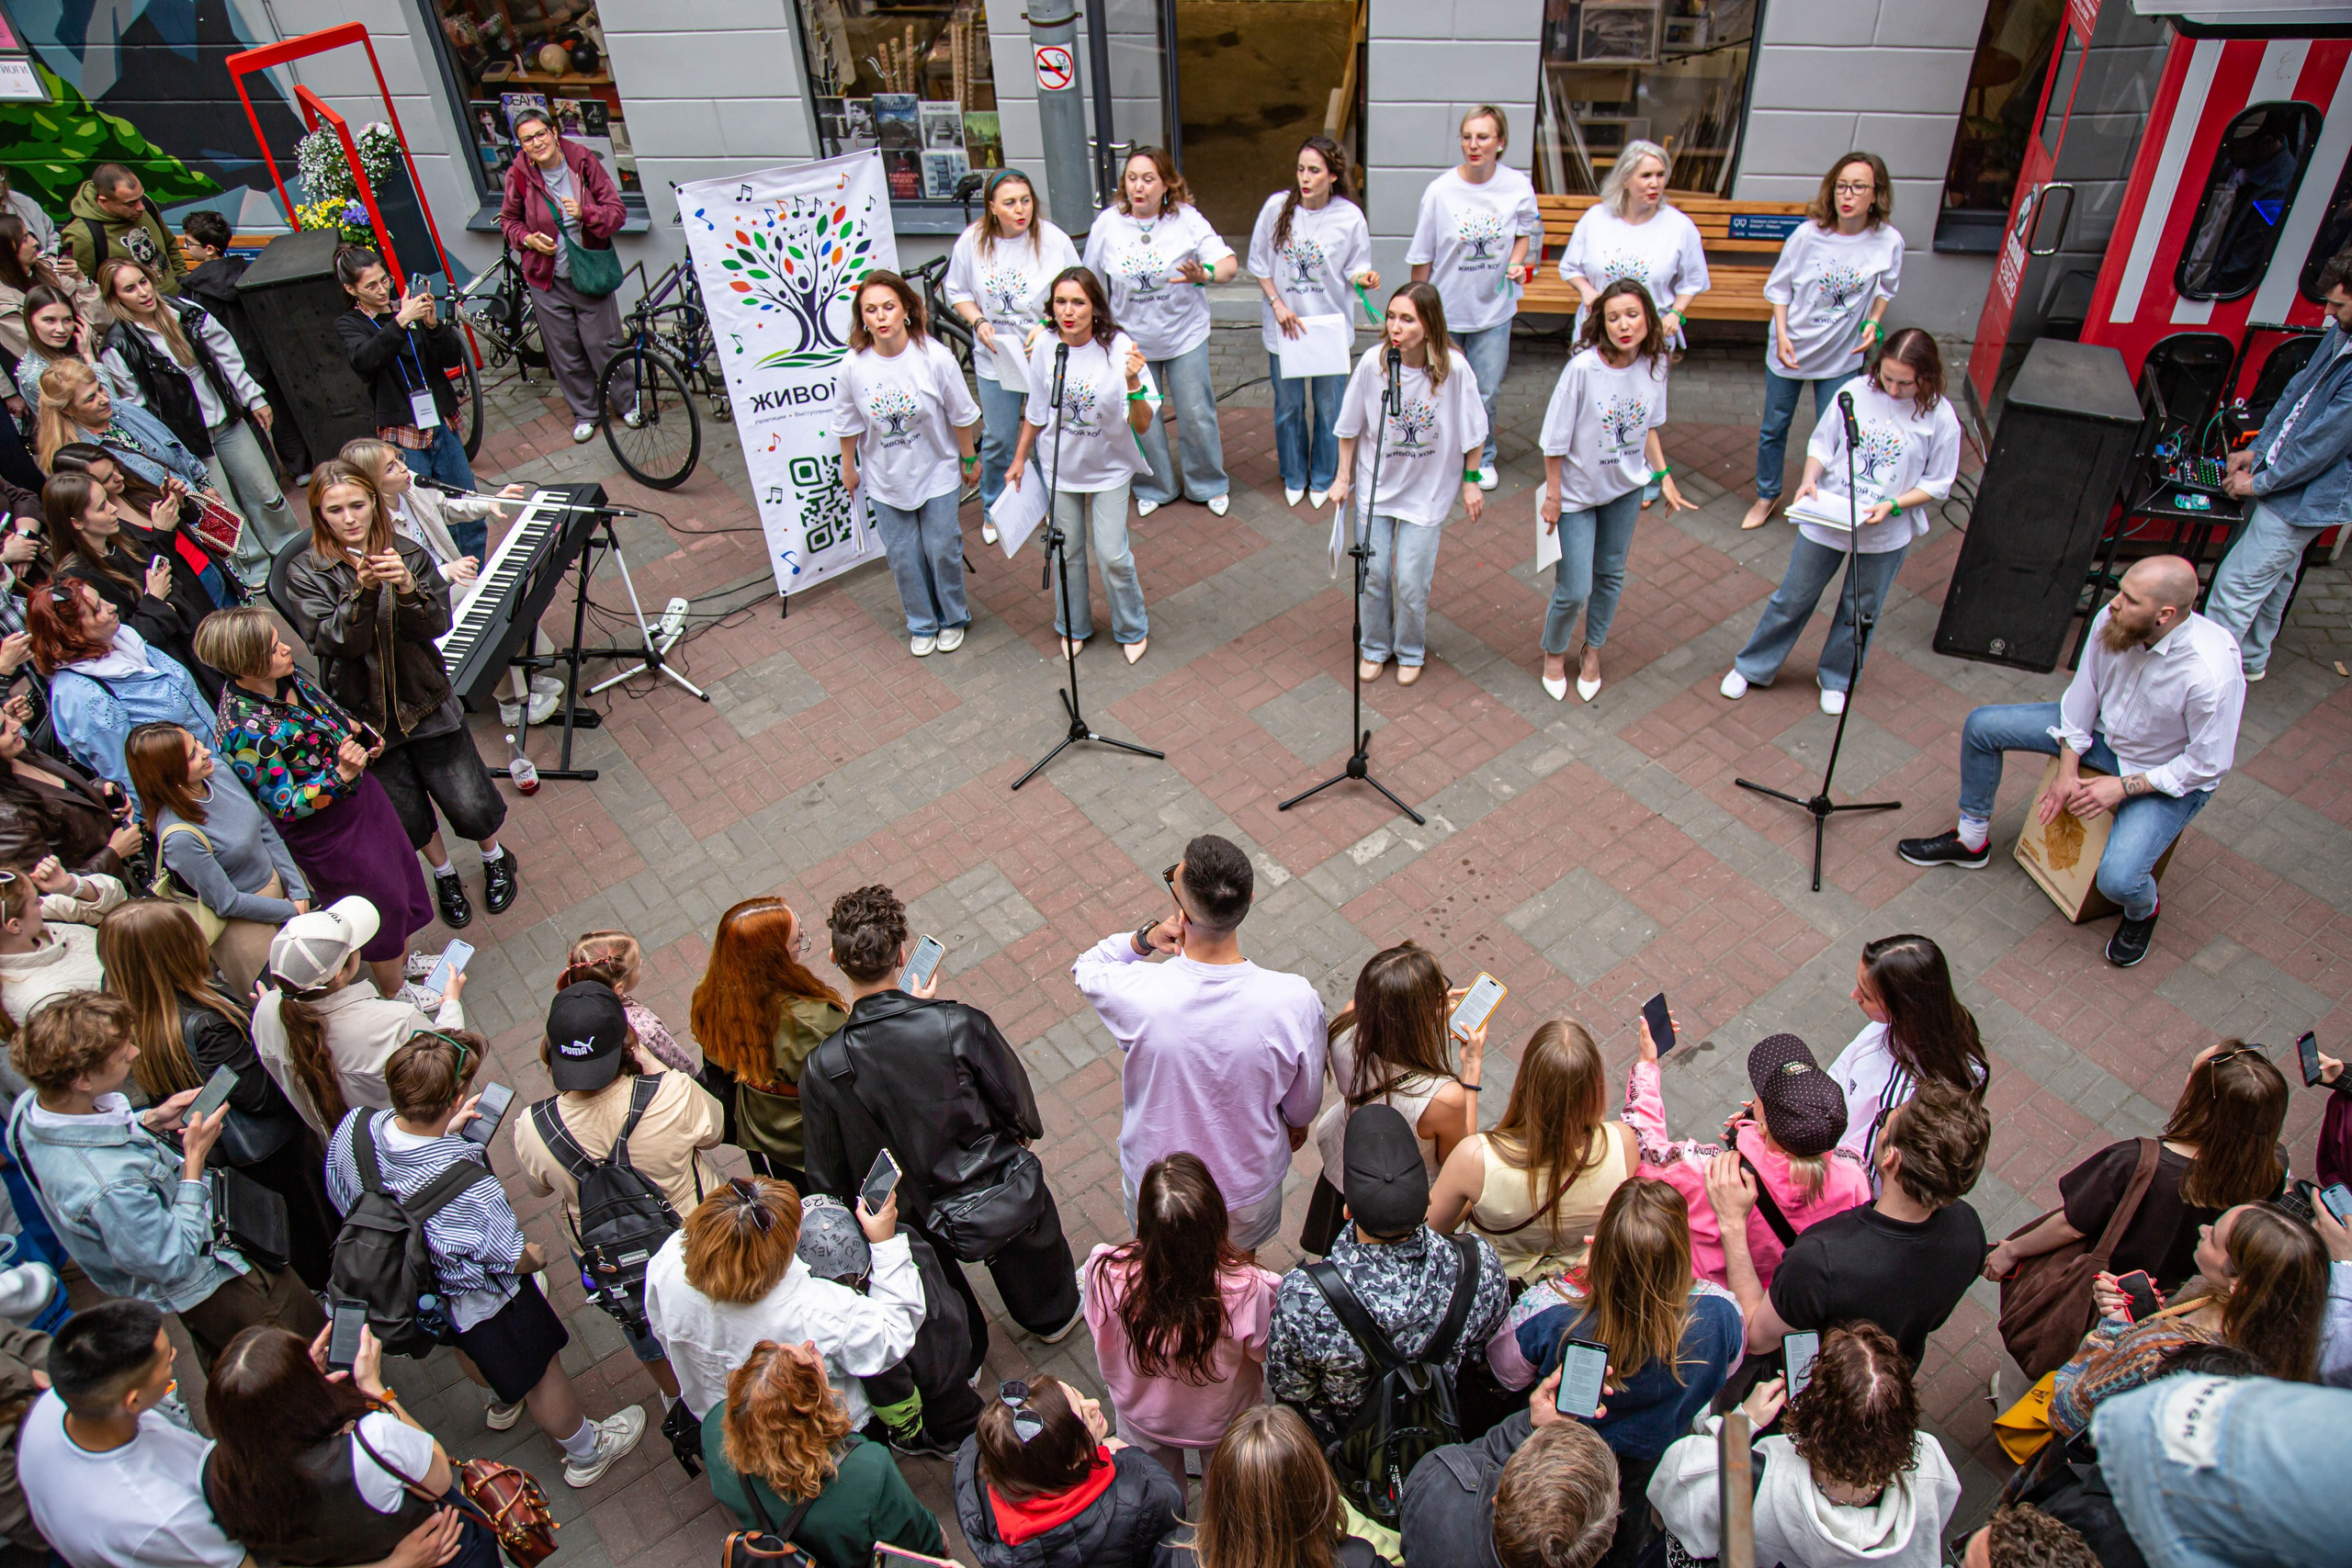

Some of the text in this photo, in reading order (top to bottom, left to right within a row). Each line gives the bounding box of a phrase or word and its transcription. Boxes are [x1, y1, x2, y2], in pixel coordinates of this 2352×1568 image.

[755, 414, 786, 425] Репетиции
[1385, 449, 1435, 459] ЖИВОЙ ХОР
[1623, 448, 1641, 457] ХОР
[560, 1044, 587, 1055] PUMA
